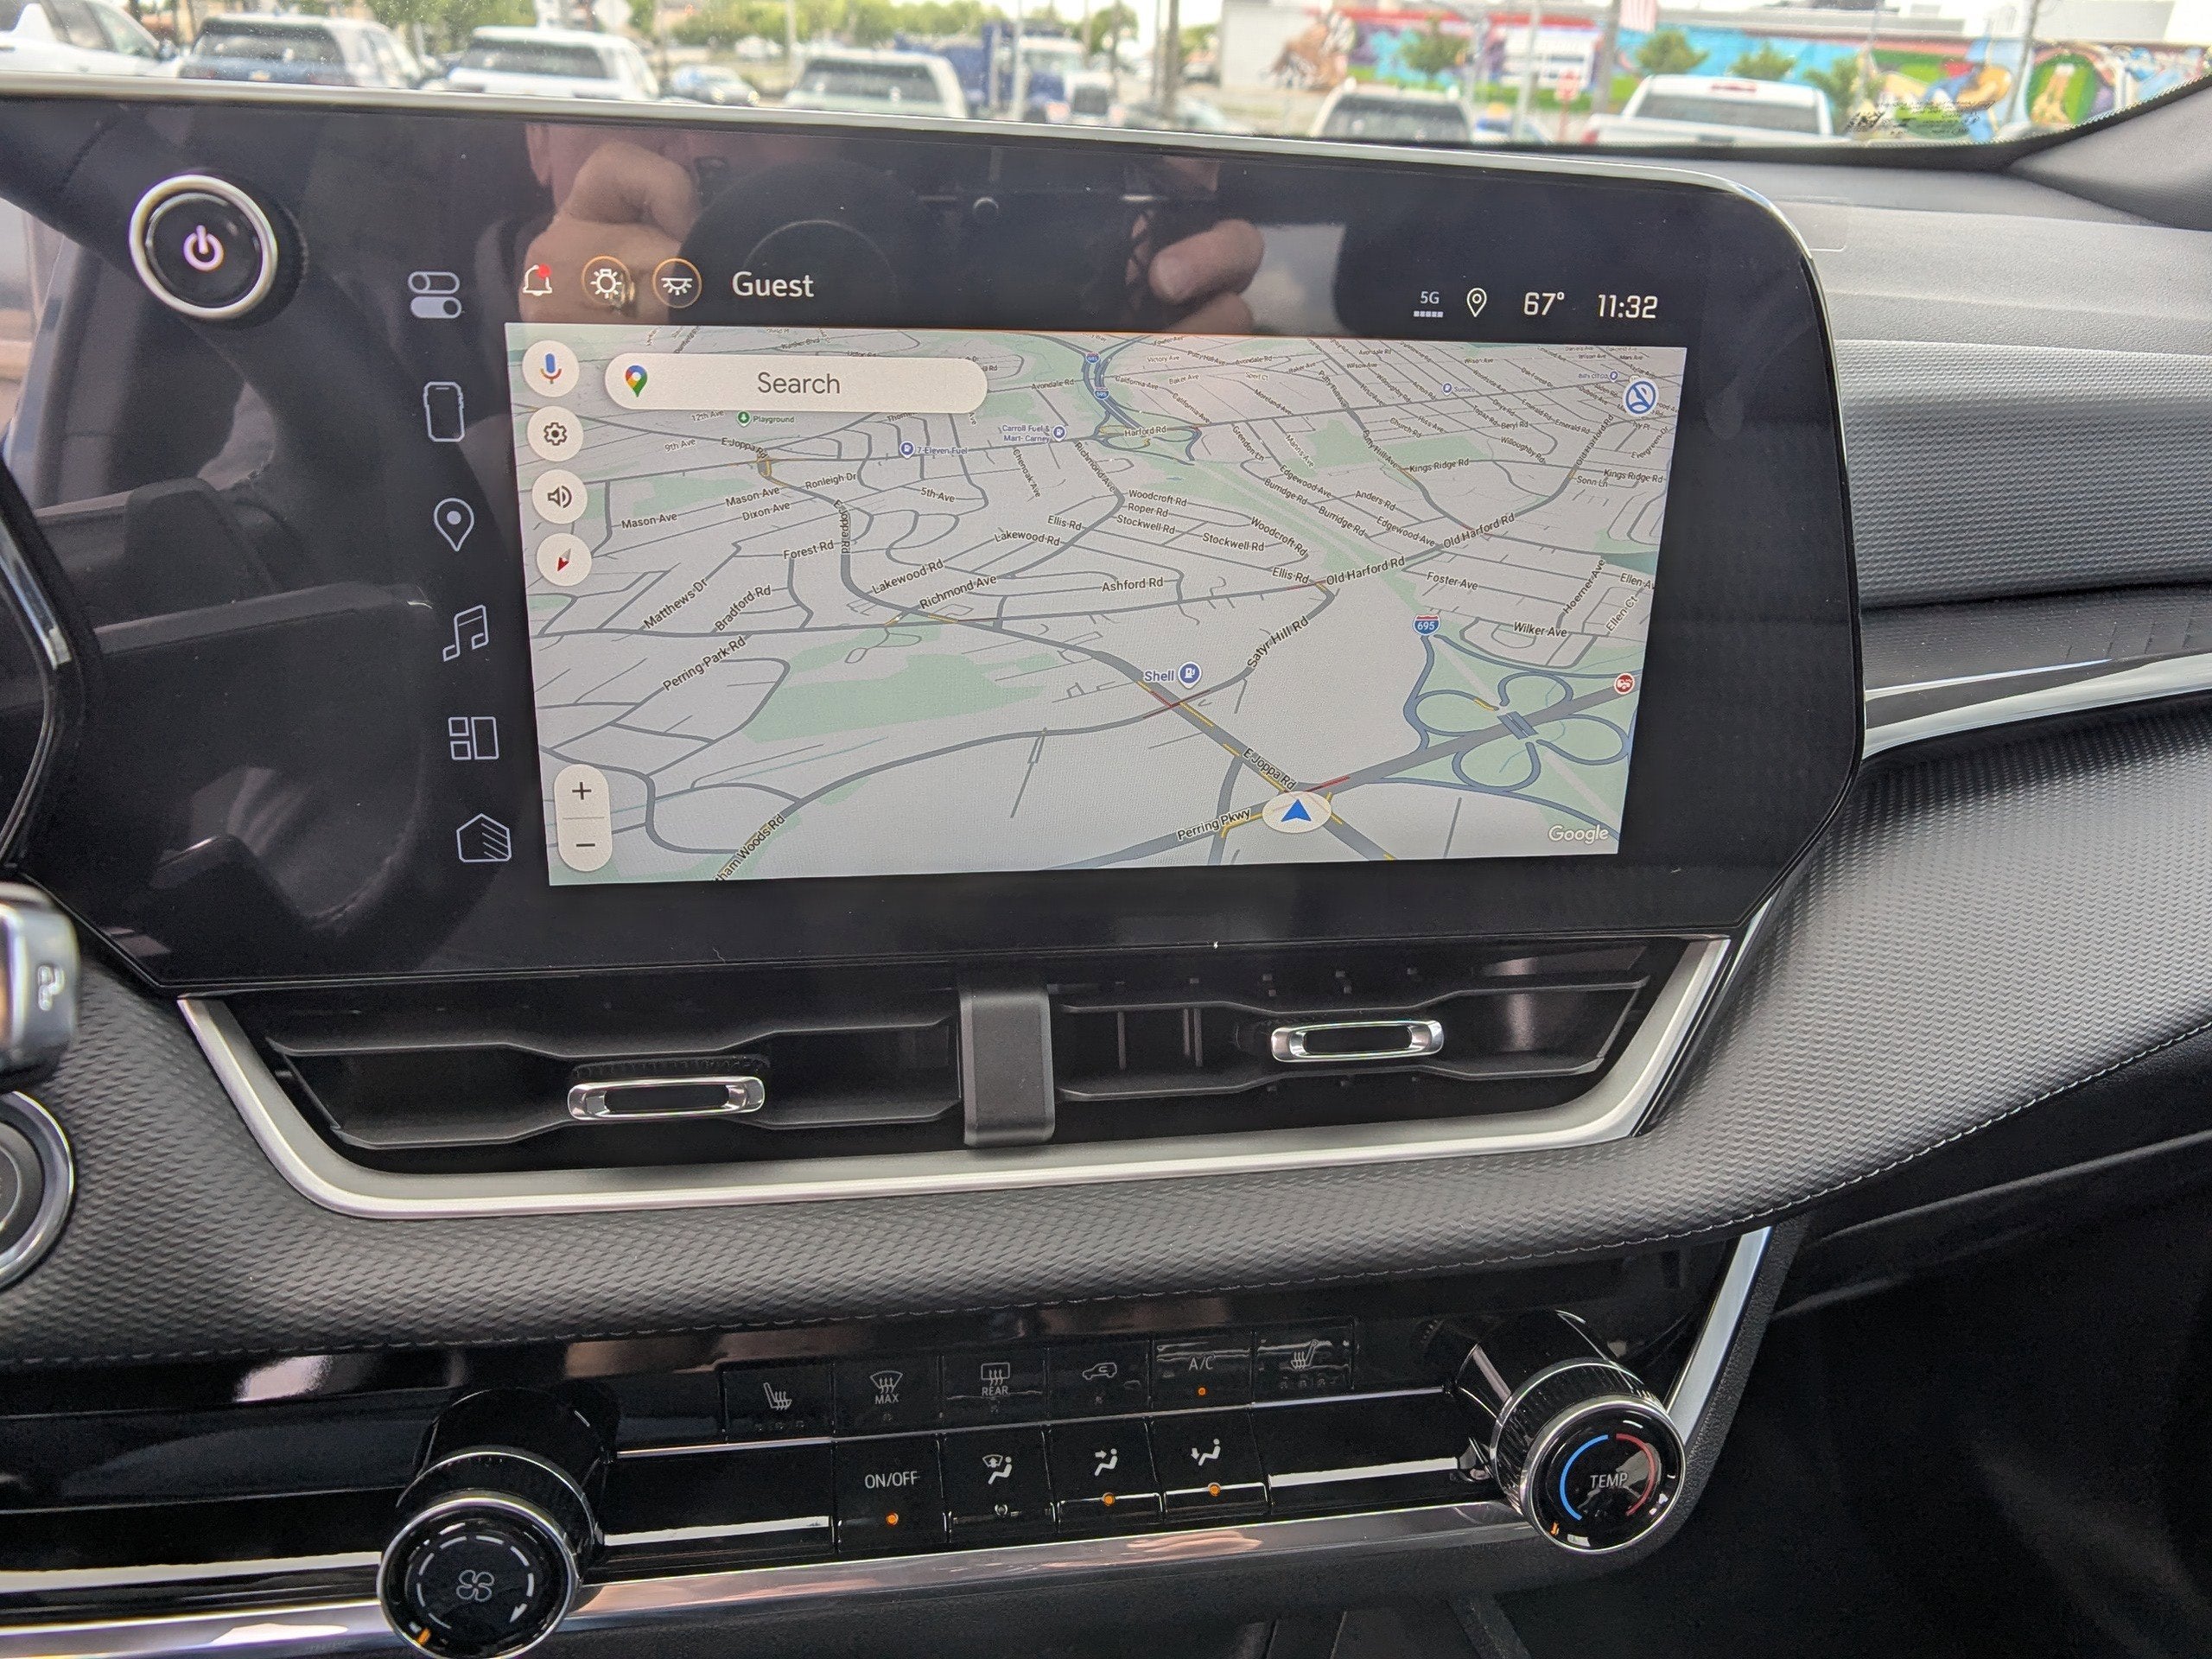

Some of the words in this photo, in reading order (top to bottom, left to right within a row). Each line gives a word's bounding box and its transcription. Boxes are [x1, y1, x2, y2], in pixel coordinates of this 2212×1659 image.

[732, 270, 815, 298] Guest
[1420, 290, 1440, 304] 5G
[1599, 293, 1658, 319] 11:32
[757, 372, 841, 394] Search
[1032, 380, 1065, 390] Avondale
[691, 412, 709, 422] 12th
[1198, 412, 1211, 424] Ave
[1279, 404, 1293, 415] Ave
[753, 415, 795, 425] Playground
[1389, 417, 1412, 434] Church
[1412, 429, 1422, 438] Rd
[1418, 416, 1432, 427] Hiss
[1433, 423, 1445, 433] Ave
[1555, 419, 1580, 432] Emerald
[1604, 415, 1614, 427] Rd
[1025, 435, 1050, 444] Carney
[1124, 428, 1154, 438] Harford
[664, 442, 678, 453] 9th
[680, 438, 696, 448] Ave
[721, 437, 728, 446] E
[729, 438, 757, 454] Joppa
[756, 445, 769, 459] Rd
[1232, 425, 1256, 455] Grendon
[1255, 452, 1265, 462] Ln
[1285, 434, 1306, 457] Manns
[1303, 454, 1314, 467] Ave
[1501, 436, 1535, 458] Willoughby
[1535, 453, 1546, 464] Rd
[1630, 434, 1662, 460] Evergreen
[1660, 426, 1669, 436] Dr
[1074, 442, 1105, 480] Richmond
[1102, 478, 1116, 493] Ave
[1385, 455, 1399, 468] Ave
[1409, 464, 1433, 474] Kings
[1434, 461, 1456, 470] Ridge
[1459, 458, 1469, 467] Rd
[805, 475, 845, 490] Ronleigh
[846, 473, 857, 482] Dr
[1013, 448, 1033, 483] Chenoak
[1030, 481, 1040, 498] Ave
[1279, 464, 1319, 492] Edgewood
[1317, 486, 1332, 499] Ave
[1576, 475, 1597, 486] Sonn
[1604, 468, 1626, 480] Kings
[1628, 472, 1651, 483] Ridge
[726, 492, 760, 506] Mason
[761, 486, 780, 499] Ave
[920, 486, 938, 499] 5th
[939, 492, 956, 503] Ave
[1128, 489, 1173, 505] Woodcroft
[1175, 496, 1187, 507] Rd
[1264, 478, 1297, 499] Burridge
[1296, 495, 1308, 505] Rd
[1355, 490, 1382, 505] Anders
[1383, 500, 1396, 512] Rd
[742, 508, 771, 521] Dixon
[772, 500, 791, 512] Ave
[833, 499, 842, 509] E
[1128, 503, 1154, 516] Roper
[1155, 507, 1168, 518] Rd
[621, 518, 656, 530] Mason
[658, 512, 677, 524] Ave
[839, 509, 850, 537] Joppa
[1047, 515, 1068, 528] Ellis
[1069, 520, 1082, 531] Rd
[1116, 515, 1160, 531] Stockwell
[1163, 524, 1175, 535] Rd
[1318, 505, 1353, 530] Burridge
[1351, 524, 1366, 537] Rd
[1443, 535, 1461, 549] Old
[1461, 519, 1499, 542] Harford
[1500, 512, 1515, 525] Rd
[994, 531, 1045, 543] Lakewood
[1046, 535, 1061, 546] Rd
[1251, 517, 1295, 549] Woodcroft
[1293, 542, 1307, 556] Rd
[1376, 516, 1420, 543] Edgewood
[1419, 535, 1435, 547] Ave
[783, 545, 818, 560] Forest
[819, 540, 835, 552] Rd
[840, 541, 850, 554] Rd
[1202, 533, 1249, 550] Stockwell
[1251, 541, 1265, 552] Rd
[872, 567, 926, 594] Lakewood
[928, 558, 944, 571] Rd
[1272, 568, 1294, 582] Ellis
[1295, 573, 1309, 585] Rd
[1325, 574, 1345, 586] Old
[1347, 561, 1389, 582] Harford
[1389, 556, 1405, 568] Rd
[1102, 578, 1147, 592] Ashford
[1148, 576, 1164, 588] Rd
[1427, 571, 1458, 587] Foster
[1459, 580, 1478, 591] Ave
[1562, 580, 1594, 614] Hoerner
[1592, 558, 1605, 579] Ave
[1620, 573, 1643, 588] Ellen
[1643, 580, 1656, 590] Av
[919, 582, 974, 610] Richmond
[976, 575, 997, 588] Ave
[643, 589, 696, 630] Matthews
[692, 577, 708, 593] Dr
[715, 593, 754, 632] Bradford
[754, 585, 772, 598] Rd
[1605, 608, 1628, 632] Ellen
[1625, 595, 1638, 610] Ct
[1417, 620, 1435, 632] 695
[1514, 621, 1546, 637] Wilker
[1547, 626, 1567, 638] Ave
[1247, 640, 1271, 668] Satyr
[1270, 626, 1292, 645] Hill
[1292, 615, 1309, 632] Rd
[663, 664, 705, 692] Perring
[702, 648, 729, 668] Park
[728, 636, 747, 652] Rd
[1144, 671, 1175, 682] Shell
[1243, 747, 1253, 760] E
[1251, 754, 1281, 785] Joppa
[1279, 773, 1297, 791] Rd
[1177, 820, 1220, 841] Perring
[1220, 808, 1251, 827] Pkwy
[1548, 824, 1609, 845] Google
[714, 858, 741, 881] tham
[736, 827, 772, 859] Woods
[767, 813, 785, 830] Rd
[1188, 1356, 1213, 1372] A/C
[874, 1394, 899, 1406] MAX
[982, 1386, 1009, 1397] REAR
[864, 1471, 920, 1490] ON/OFF
[1589, 1472, 1628, 1489] TEMP
